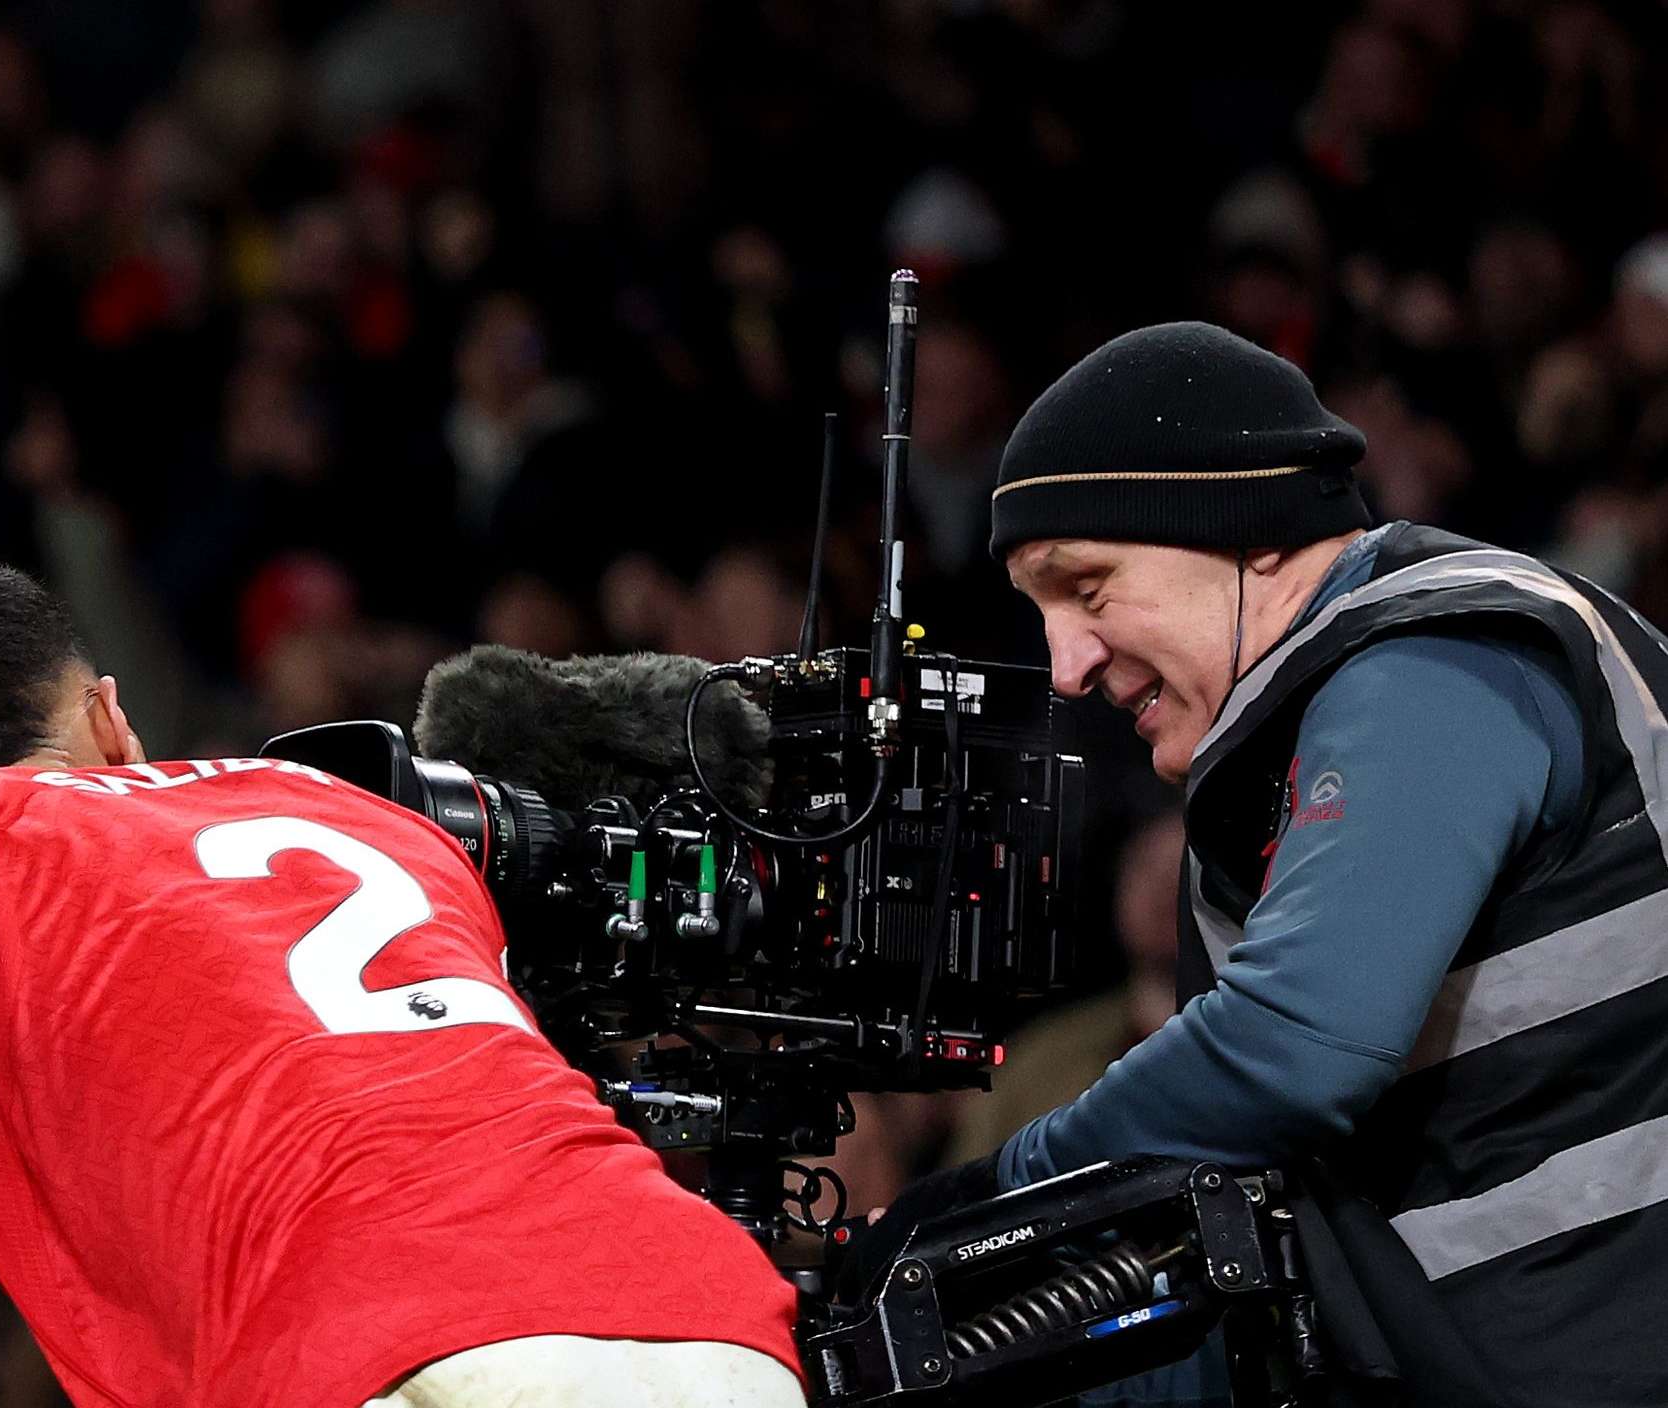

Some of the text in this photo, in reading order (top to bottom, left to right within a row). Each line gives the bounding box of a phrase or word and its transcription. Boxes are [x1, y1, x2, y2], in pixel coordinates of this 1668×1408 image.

[444, 807, 475, 820] Canon
[194, 816, 538, 1036] 2
[957, 1225, 1037, 1261] STEADICAM
[1117, 1308, 1151, 1328] G-50
